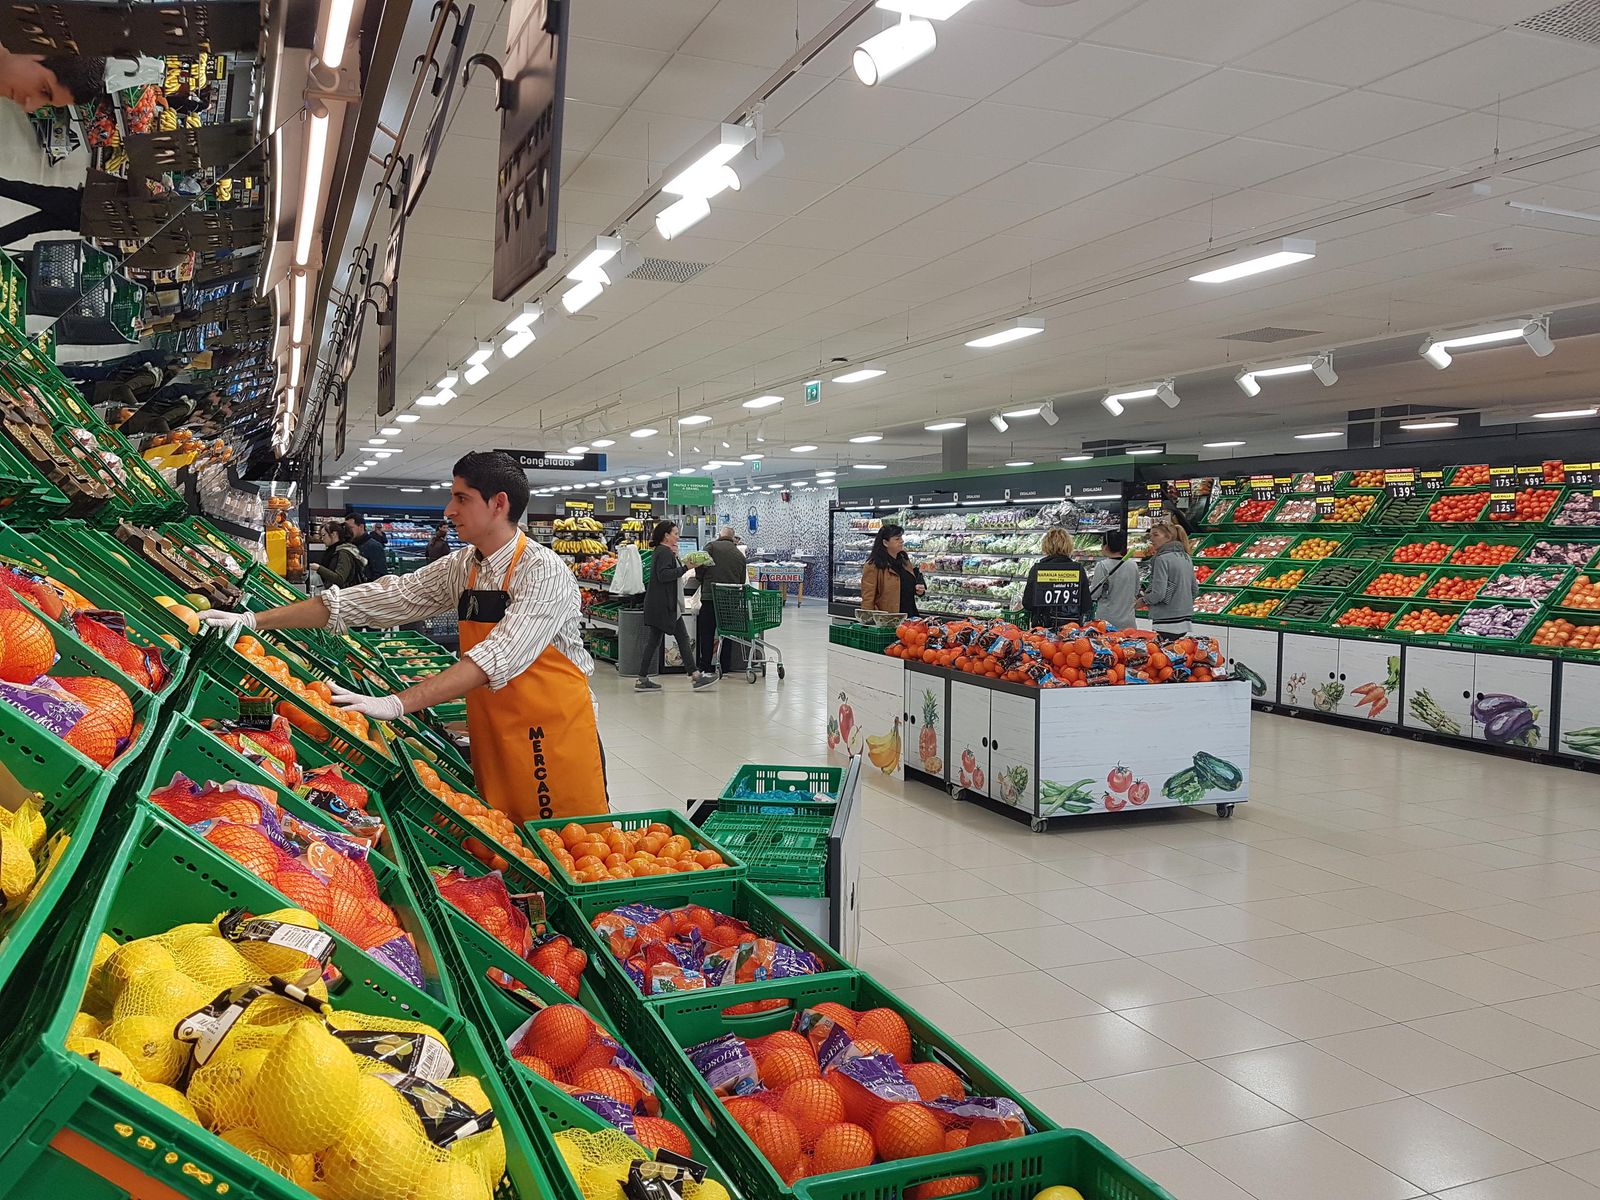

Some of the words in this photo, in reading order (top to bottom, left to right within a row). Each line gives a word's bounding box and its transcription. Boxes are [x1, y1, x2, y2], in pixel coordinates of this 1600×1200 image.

[520, 456, 574, 467] Congelados
[1571, 475, 1587, 483] 199
[1258, 492, 1271, 500] 119
[1393, 487, 1410, 497] 139
[1496, 504, 1510, 512] 125
[0, 693, 62, 733] aranjas
[529, 726, 553, 819] MERCADO
